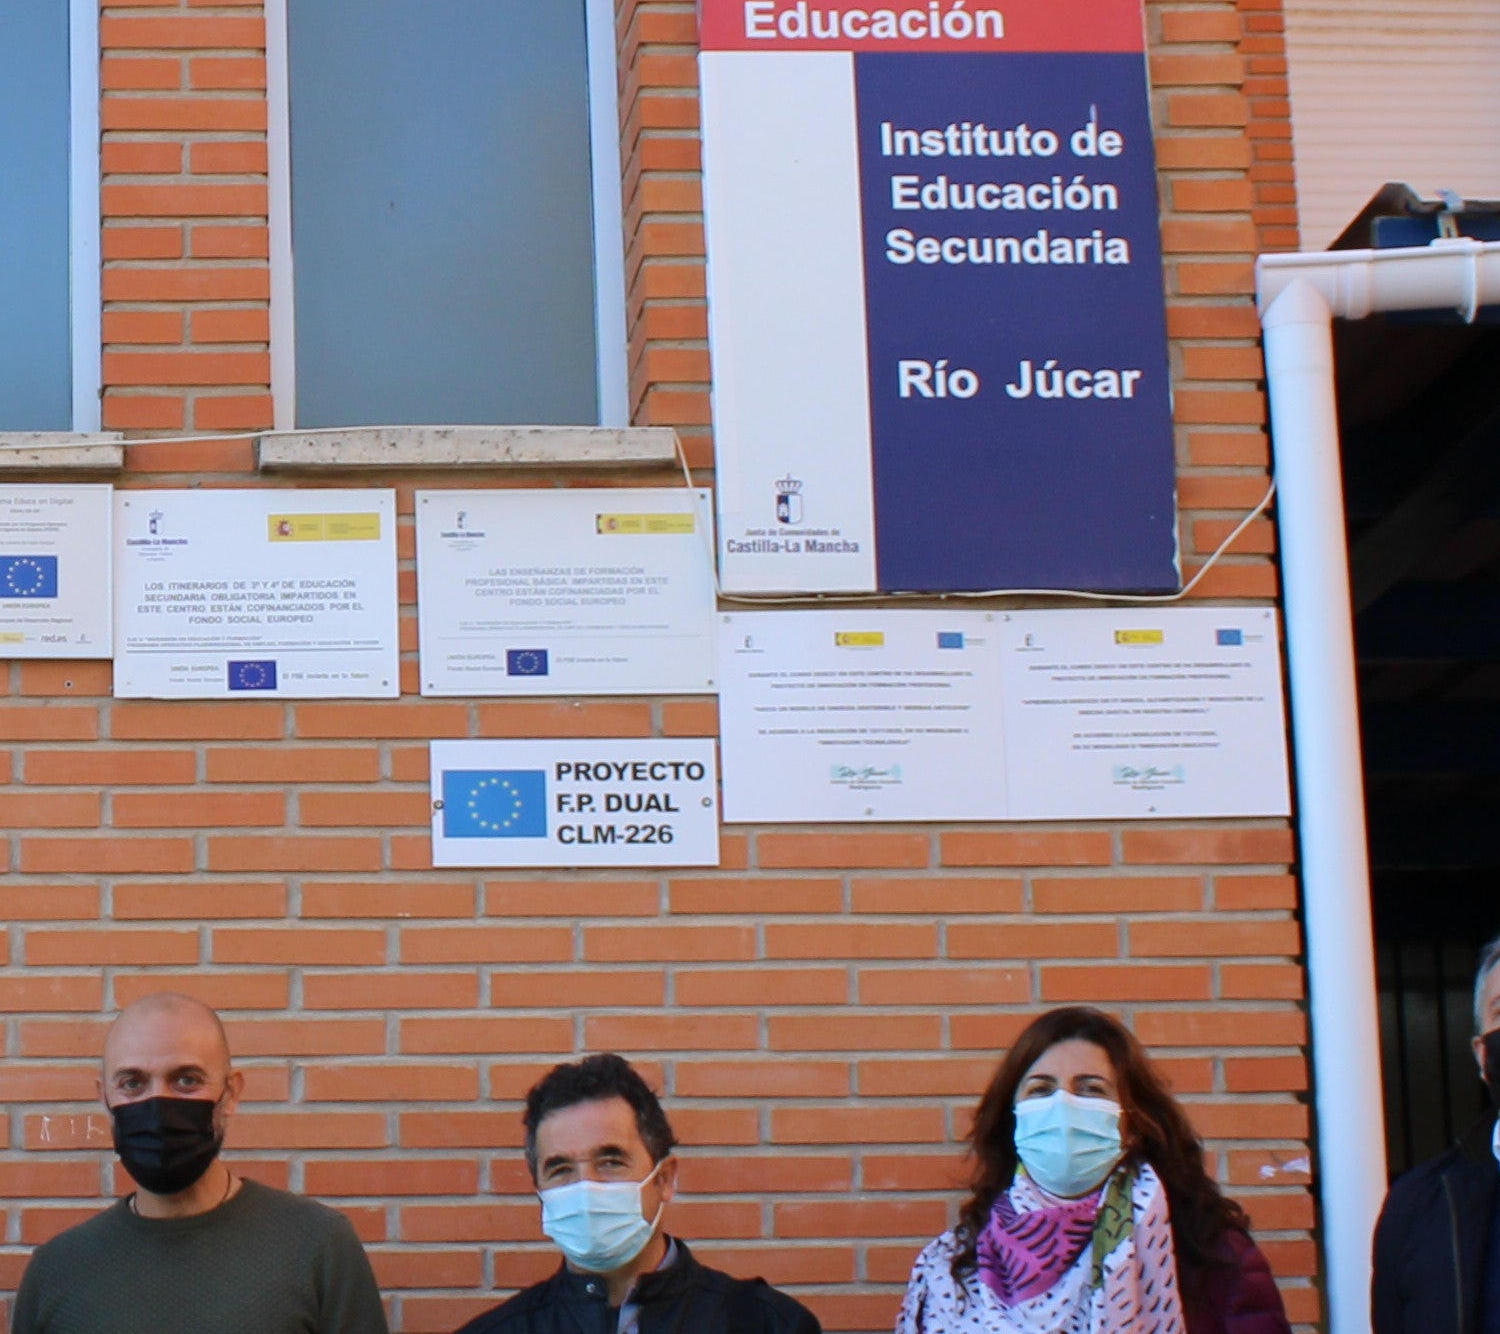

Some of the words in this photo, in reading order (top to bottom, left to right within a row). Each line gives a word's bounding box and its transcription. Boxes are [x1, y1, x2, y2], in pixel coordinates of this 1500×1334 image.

[744, 0, 1004, 39] Educación
[882, 122, 1058, 157] Instituto
[1071, 122, 1122, 157] de
[891, 177, 1118, 210] Educación
[886, 229, 1130, 264] Secundaria
[899, 359, 978, 399] Río
[1005, 359, 1141, 399] Júcar
[727, 540, 800, 553] Castilla-La
[805, 540, 859, 553] Mancha
[169, 582, 228, 590] ITINERARIOS
[233, 581, 245, 589] DE
[252, 581, 260, 589] 3º
[263, 581, 269, 589] Y
[271, 581, 280, 589] 4º
[282, 581, 294, 589] DE
[300, 579, 355, 589] EDUCACIÓN
[145, 594, 205, 602] SECUNDARIA
[211, 593, 274, 601] OBLIGATORIA
[280, 592, 338, 600] IMPARTIDOS
[510, 598, 542, 606] FONDO
[581, 597, 625, 605] EUROPEO
[138, 605, 161, 613] ESTE
[167, 605, 204, 613] CENTRO
[211, 603, 241, 613] ESTÁN
[248, 603, 324, 612] COFINANCIADOS
[330, 603, 349, 611] POR
[352, 602, 363, 610] EL
[189, 616, 222, 625] FONDO
[228, 616, 261, 624] SOCIAL
[268, 615, 312, 623] EUROPEO
[556, 763, 704, 782] PROYECTO
[557, 794, 595, 812] F.P.
[605, 794, 678, 812] DUAL
[557, 825, 673, 844] CLM-226
